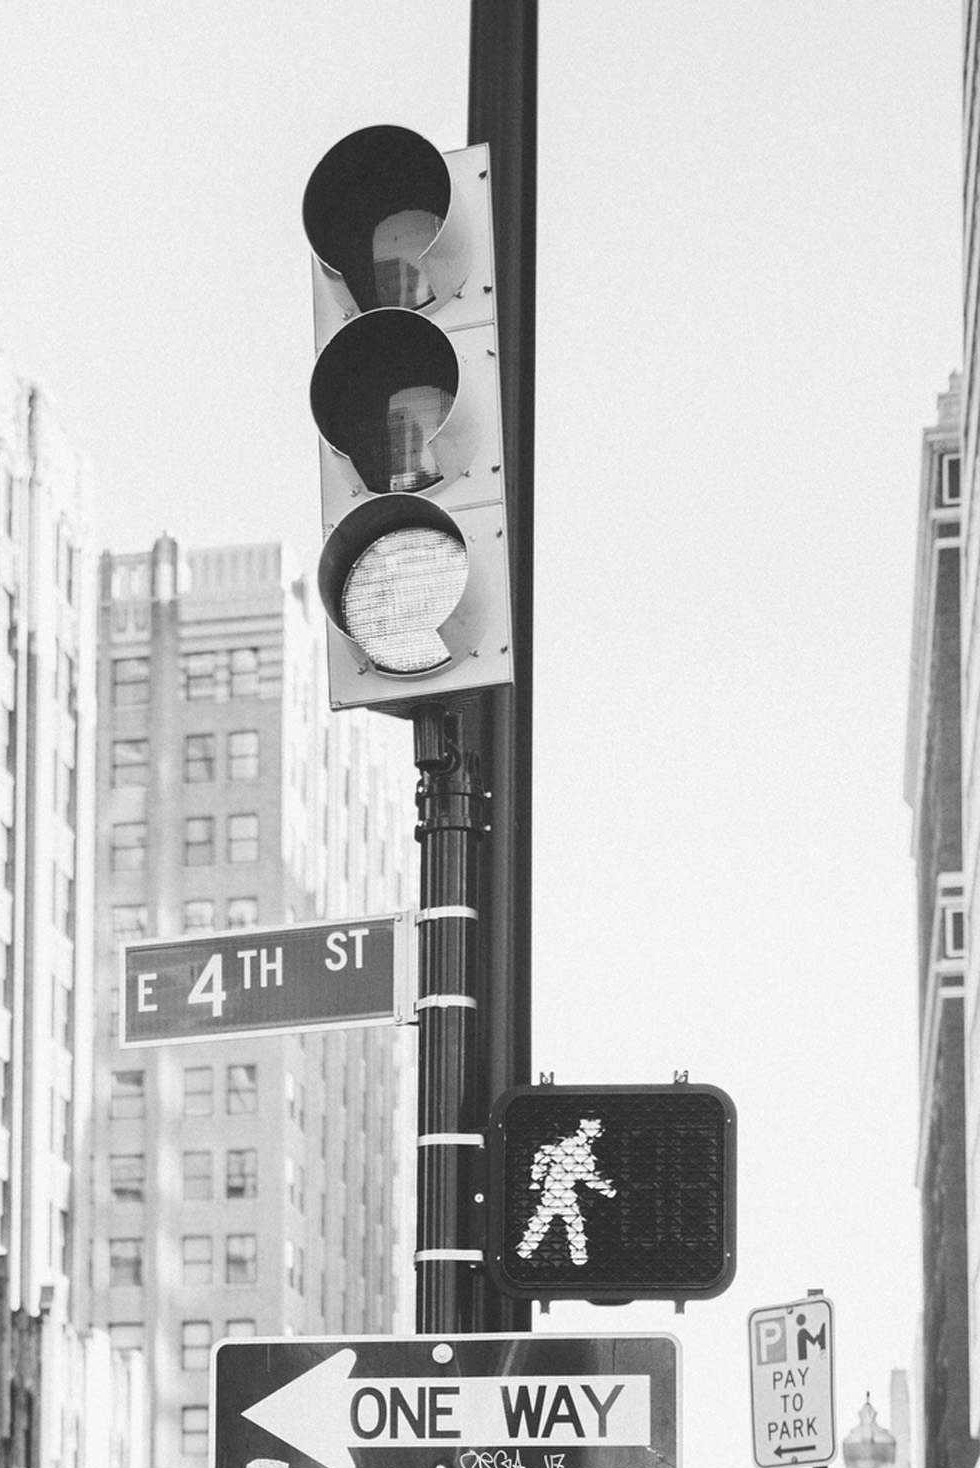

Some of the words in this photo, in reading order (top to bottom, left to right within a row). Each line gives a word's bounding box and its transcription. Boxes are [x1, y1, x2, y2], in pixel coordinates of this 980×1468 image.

[137, 973, 158, 1013] E
[188, 947, 283, 1017] 4TH
[325, 929, 369, 971] ST
[758, 1321, 782, 1362] P
[772, 1367, 810, 1390] PAY
[350, 1386, 461, 1441] ONE
[500, 1384, 626, 1440] WAY
[781, 1393, 804, 1414] TO
[768, 1417, 818, 1441] PARK
